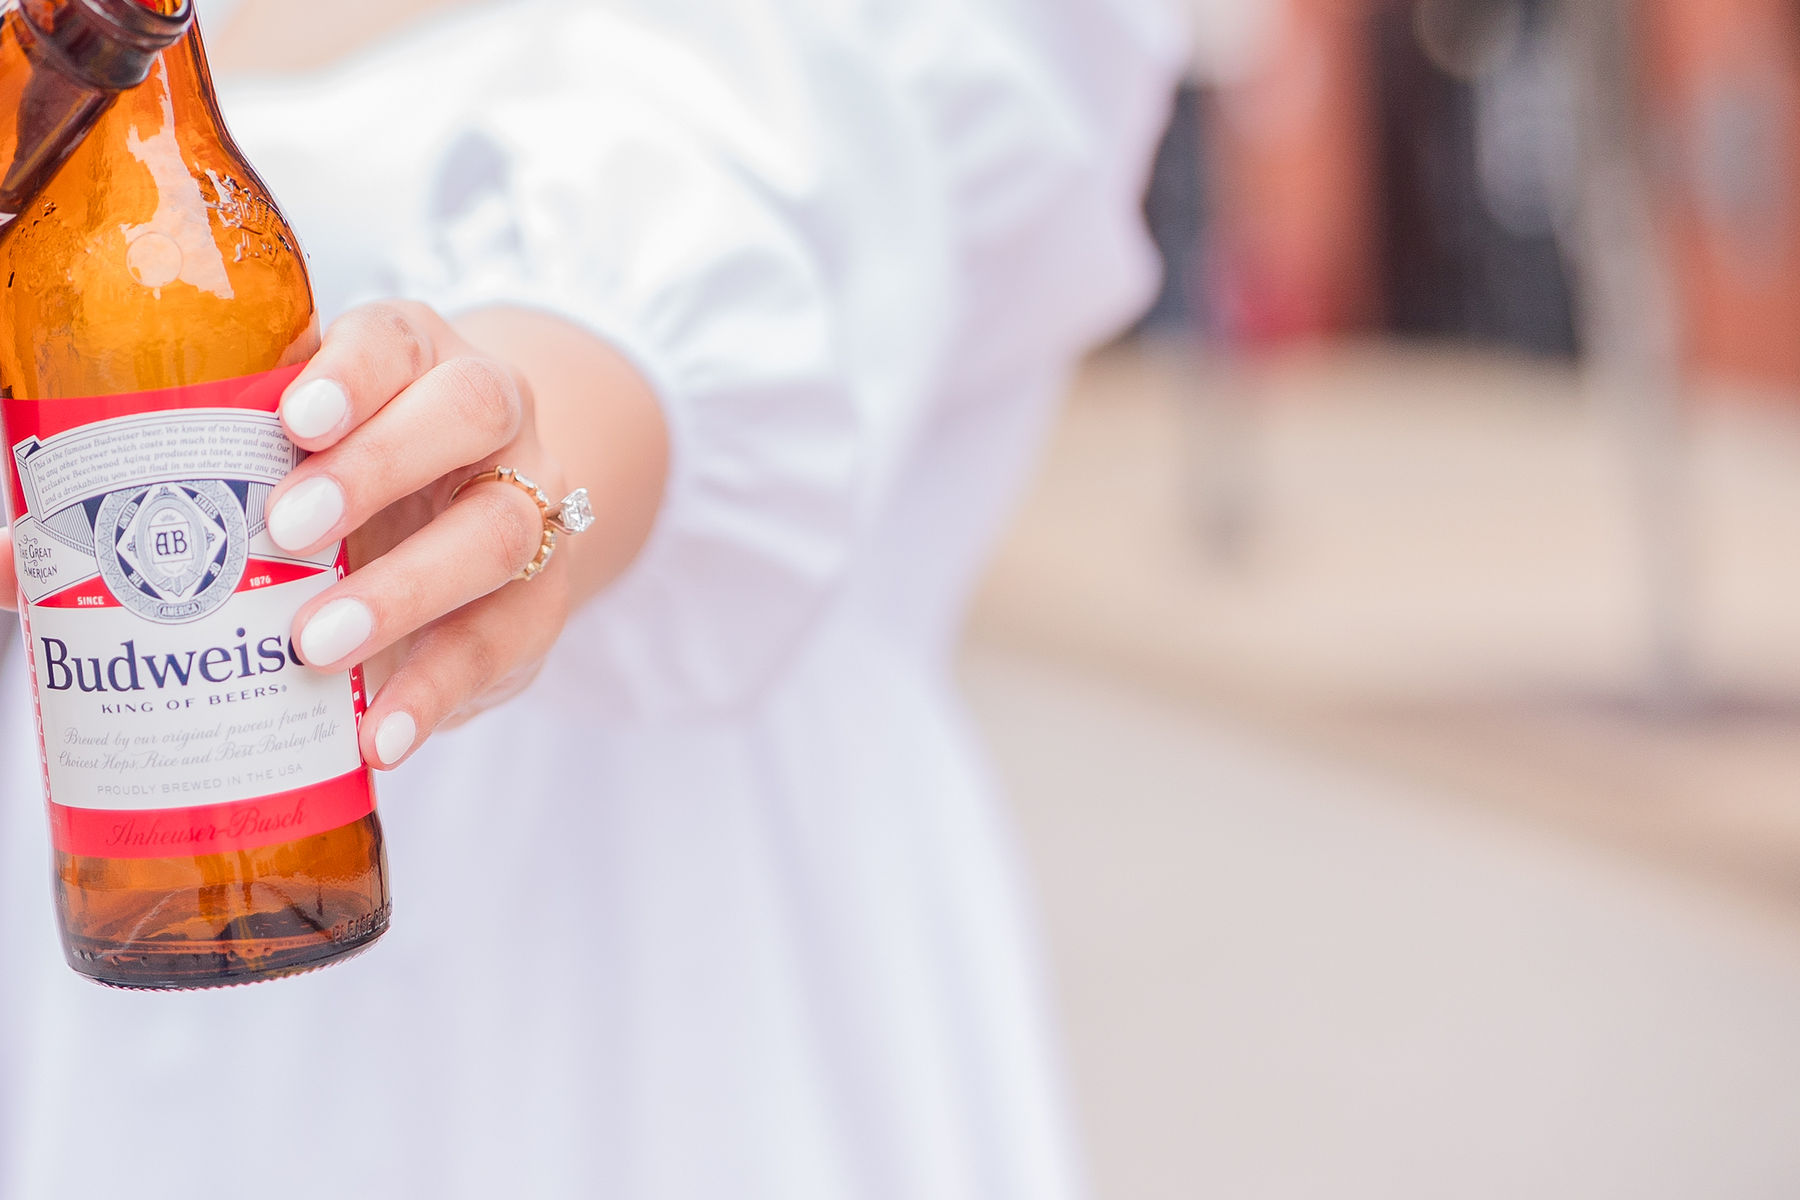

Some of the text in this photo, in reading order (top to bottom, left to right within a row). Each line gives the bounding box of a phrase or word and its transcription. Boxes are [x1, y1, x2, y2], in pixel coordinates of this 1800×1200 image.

[46, 468, 59, 479] any
[59, 460, 78, 472] other
[80, 451, 108, 464] brewer
[110, 444, 137, 455] which
[140, 439, 163, 449] costs
[180, 436, 205, 445] much
[208, 436, 217, 444] to
[219, 435, 241, 444] brew
[243, 437, 259, 447] and
[276, 442, 290, 453] Our
[64, 443, 92, 460] famous
[94, 432, 139, 448] Budweiser
[166, 426, 179, 435] We
[181, 424, 205, 433] know
[208, 423, 216, 434] of
[232, 424, 257, 435] brand
[41, 476, 72, 495] exclusive
[72, 459, 120, 478] Beechwood
[122, 453, 151, 466] Aging
[154, 449, 198, 460] produces
[244, 450, 289, 464] smoothness
[45, 493, 57, 505] and
[63, 476, 109, 495] drinkability
[111, 471, 127, 483] you
[129, 466, 146, 477] will
[149, 461, 168, 473] find
[170, 460, 180, 470] in
[183, 461, 195, 469] no
[199, 459, 221, 469] other
[223, 460, 242, 469] beer
[244, 461, 253, 470] at
[254, 463, 269, 474] any
[193, 493, 219, 520] STATES
[28, 544, 53, 561] GREAT
[155, 530, 188, 556] AB
[24, 561, 58, 583] AMERICAN
[249, 574, 272, 588] 1876
[77, 596, 105, 606] SINCE
[160, 603, 199, 617] AMERICA
[40, 627, 305, 693] Budweis
[101, 701, 154, 714] KING
[166, 698, 196, 711] OF
[63, 700, 328, 752] Brewed by our original process from the
[59, 750, 100, 769] Choicest
[134, 750, 177, 769] Rice
[180, 746, 213, 765] and
[215, 741, 255, 761] Best
[256, 733, 307, 753] Barley
[307, 719, 340, 743] Malt
[97, 763, 304, 796] PROUDLY BREWED IN THE USA
[106, 797, 306, 847] Anheuser-Busch
